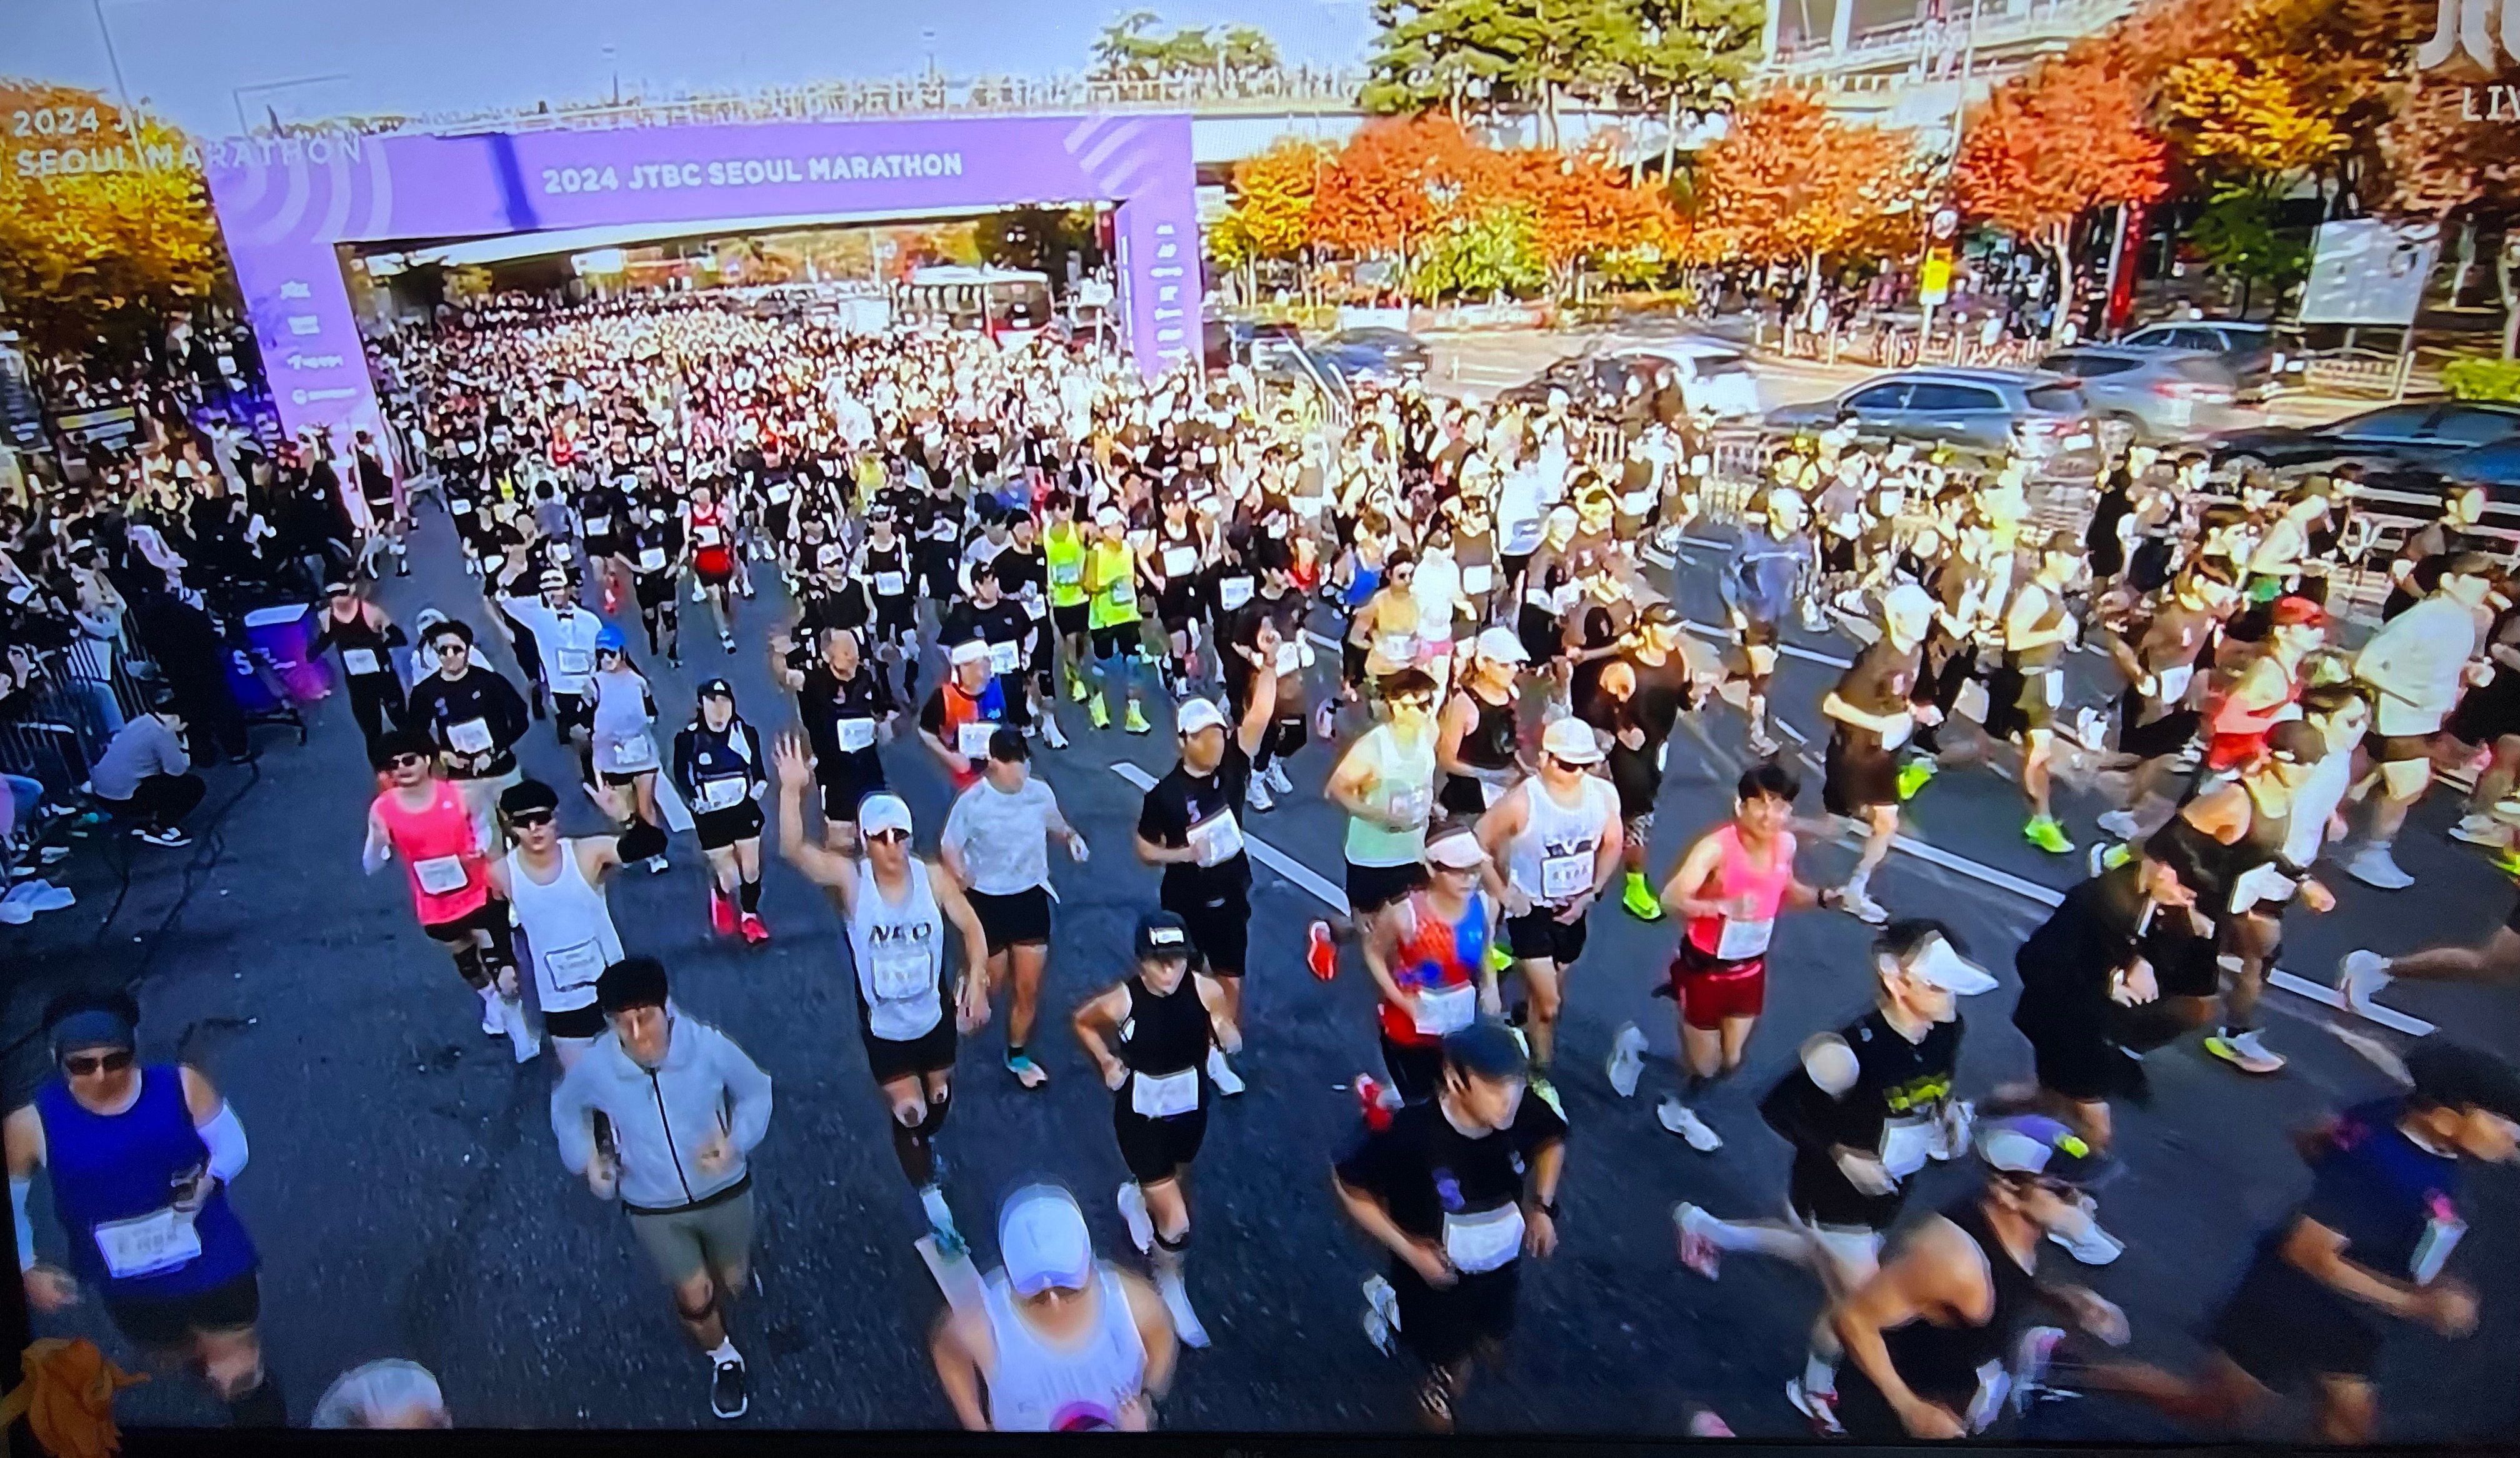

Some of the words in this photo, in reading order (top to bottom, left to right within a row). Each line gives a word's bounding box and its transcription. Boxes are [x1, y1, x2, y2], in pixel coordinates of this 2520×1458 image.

[542, 166, 619, 194] 2024
[628, 163, 702, 189] JTBC
[708, 159, 803, 186] SEOUL
[808, 153, 962, 181] MARATHON
